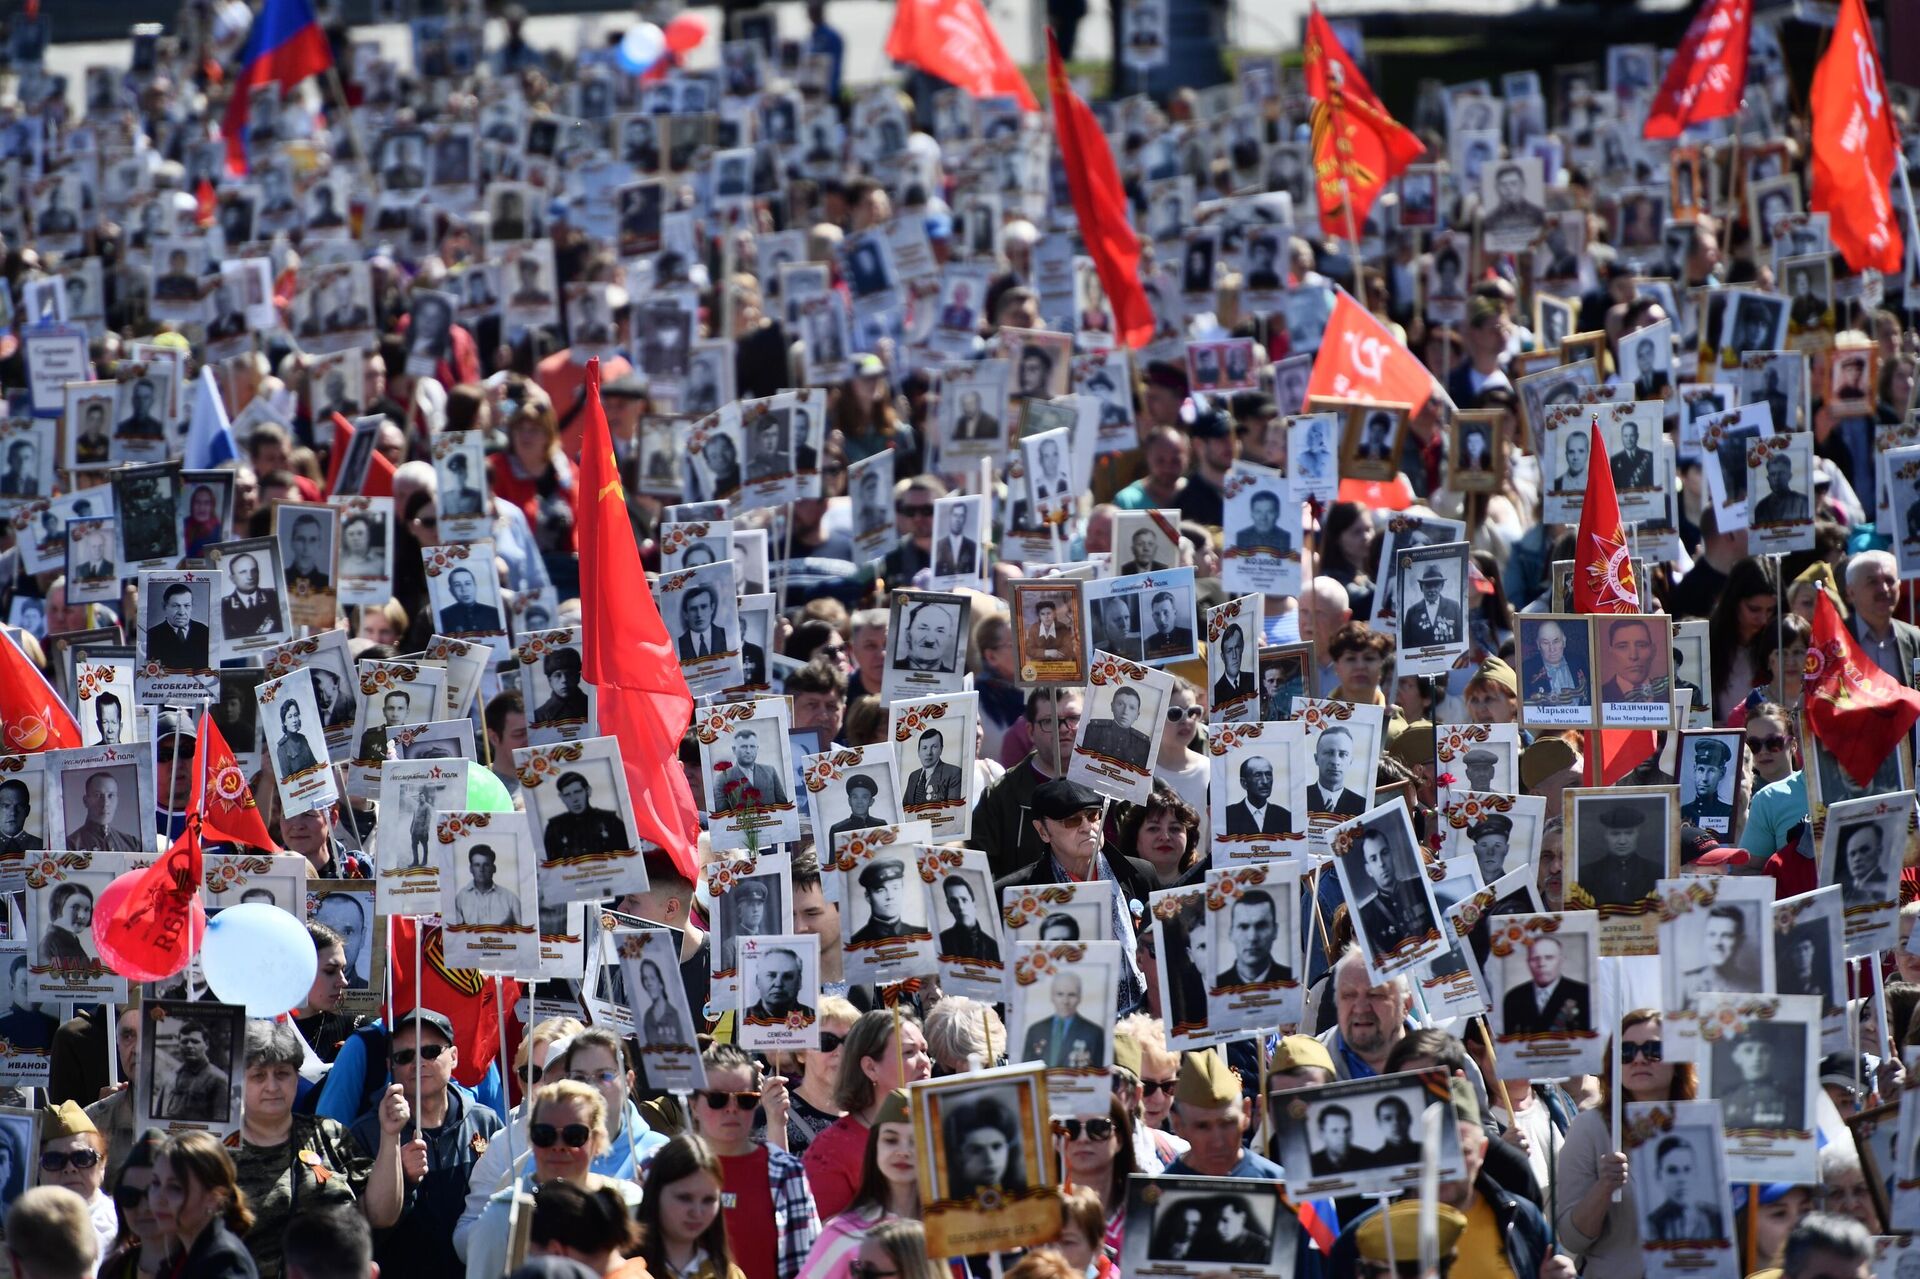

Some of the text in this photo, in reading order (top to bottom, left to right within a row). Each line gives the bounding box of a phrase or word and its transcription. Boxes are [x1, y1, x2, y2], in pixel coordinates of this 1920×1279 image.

[142, 691, 214, 699] Иван Антонович
[1536, 706, 1580, 716] Марьясов
[1610, 703, 1665, 713] Владимиров
[1622, 715, 1669, 723] Митрофанович
[7, 1062, 48, 1070] ИВАНОВ
